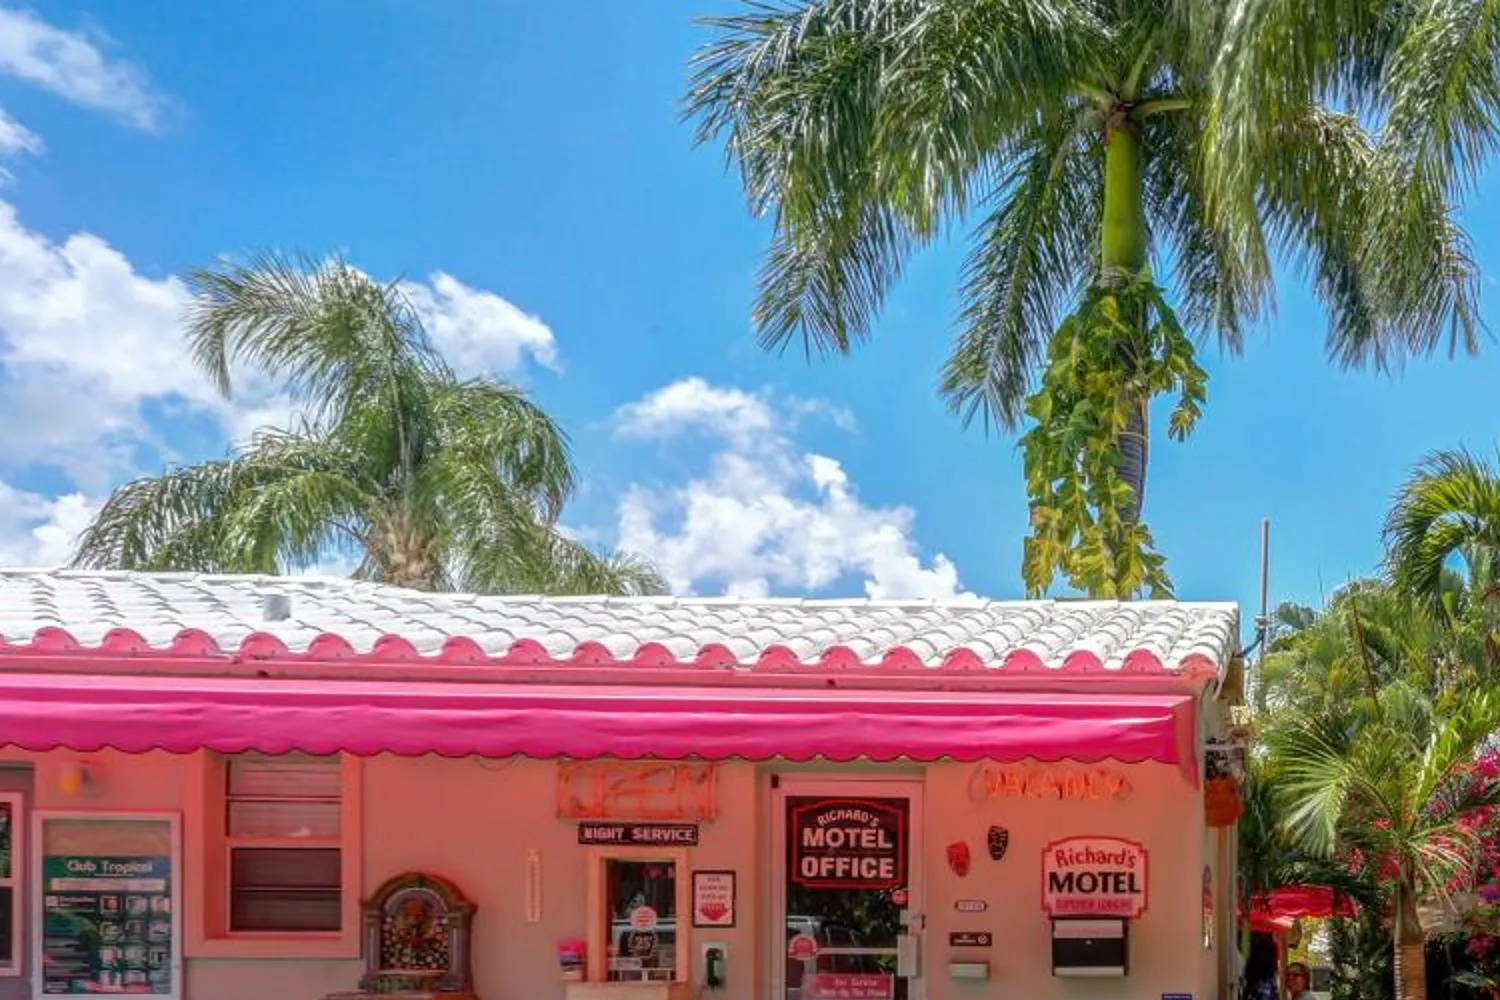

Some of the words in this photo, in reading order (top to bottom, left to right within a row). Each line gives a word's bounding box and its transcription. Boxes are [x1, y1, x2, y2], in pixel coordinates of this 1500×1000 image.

[817, 809, 880, 827] RICHARD'S
[584, 827, 624, 840] NIGHT
[632, 827, 693, 841] SERVICE
[802, 827, 893, 848] MOTEL
[65, 859, 96, 872] Club
[801, 856, 894, 878] OFFICE
[1055, 846, 1137, 868] Richard's
[1049, 871, 1142, 893] MOTEL
